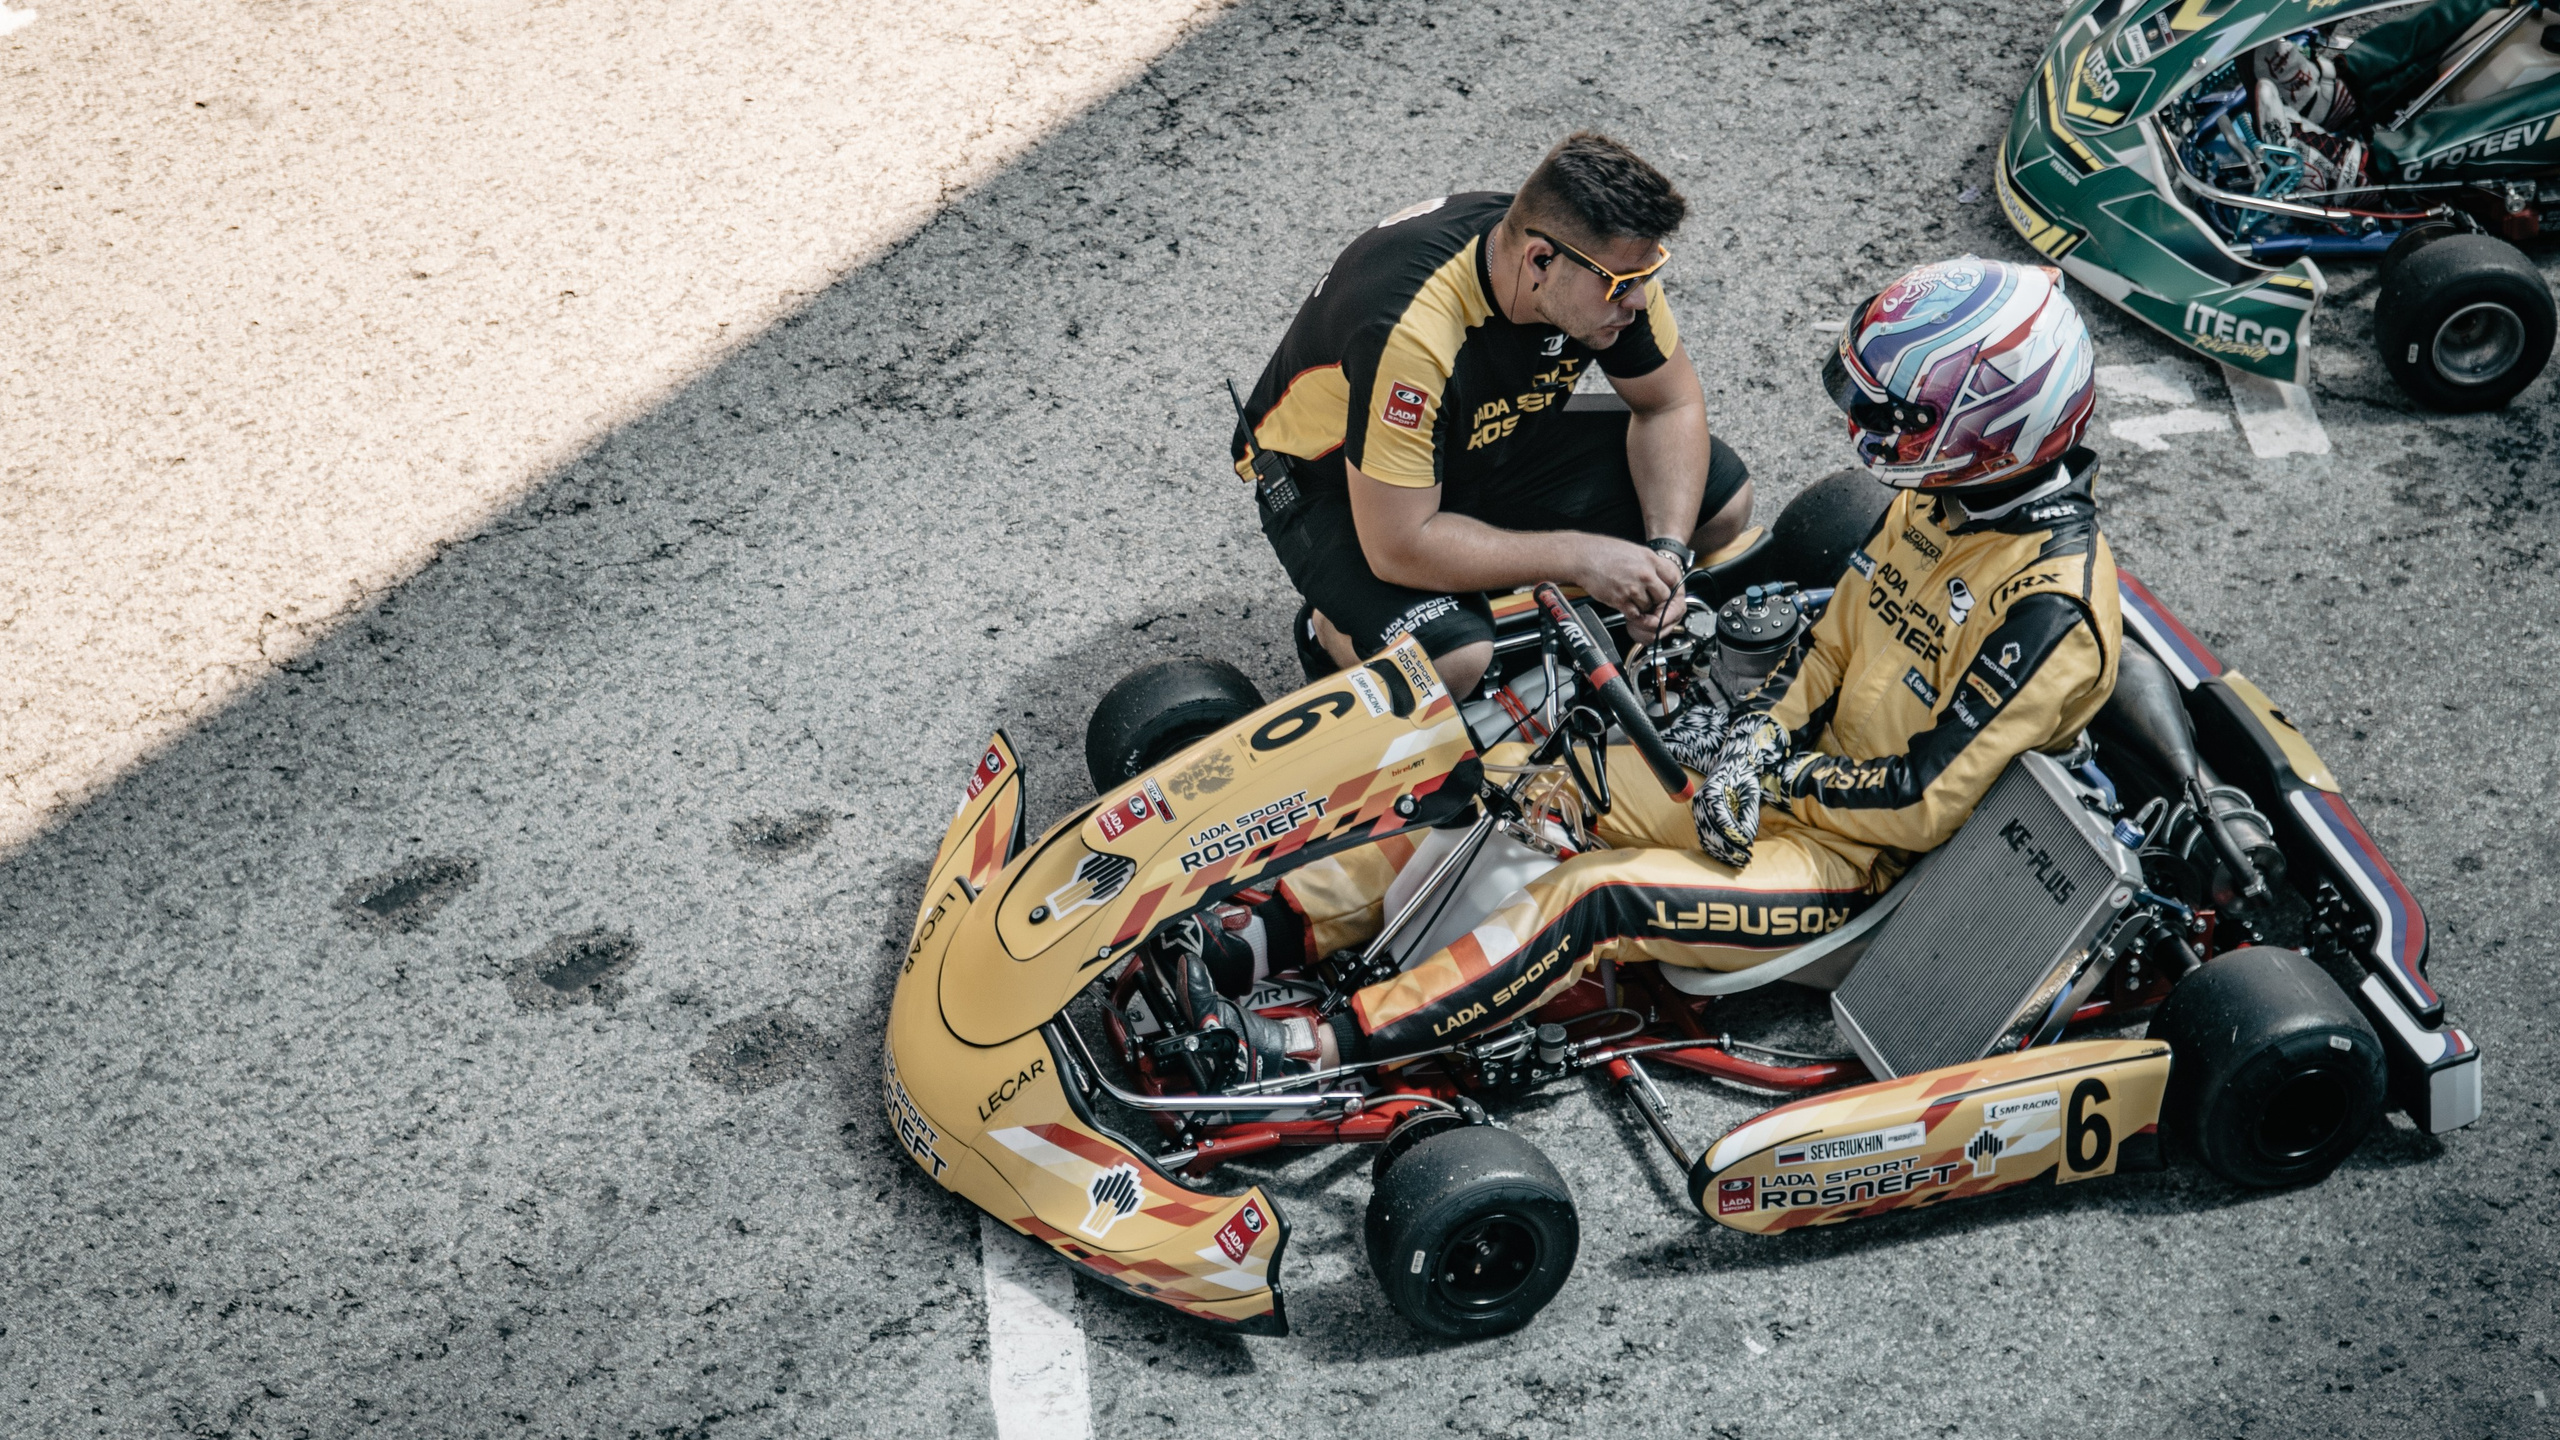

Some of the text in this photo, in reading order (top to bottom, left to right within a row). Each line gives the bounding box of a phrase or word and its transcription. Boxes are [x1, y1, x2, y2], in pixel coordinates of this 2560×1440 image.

[2086, 47, 2120, 102] ITECO
[2184, 301, 2290, 355] ITECO
[1388, 415, 1415, 426] SPORT
[1389, 406, 1417, 422] LADA
[1878, 563, 1908, 597] ADA
[2001, 572, 2065, 602] HRX
[1380, 595, 1454, 641] LADA SPORT
[1395, 648, 1433, 699] ROSNEFT
[1416, 660, 1435, 688] SPORT
[1356, 676, 1384, 715] SMP RACING
[1250, 691, 1356, 751] 6
[1100, 814, 1117, 837] SPORT
[1107, 808, 1125, 834] LADA
[1180, 796, 1330, 875] ROSNEFT
[1189, 789, 1309, 848] LADA SPORT
[904, 891, 956, 975] LECAR
[1648, 900, 1850, 935] ROSNEFT
[1433, 935, 1571, 1037] LADA SPORT
[978, 1059, 1045, 1122] LECAR
[1999, 1097, 2058, 1116] SMP RACING
[895, 1081, 939, 1144] SPORT
[2066, 1078, 2112, 1173] 6
[1810, 1135, 1883, 1160] SEVERIUKHIN
[1760, 1162, 1959, 1211] ROSNEFT
[1761, 1156, 1921, 1189] LADA SPORT
[1722, 1197, 1751, 1208] LADA
[1722, 1204, 1751, 1213] SPORT
[1219, 1233, 1241, 1260] SPORT
[1224, 1224, 1245, 1254] LADA
